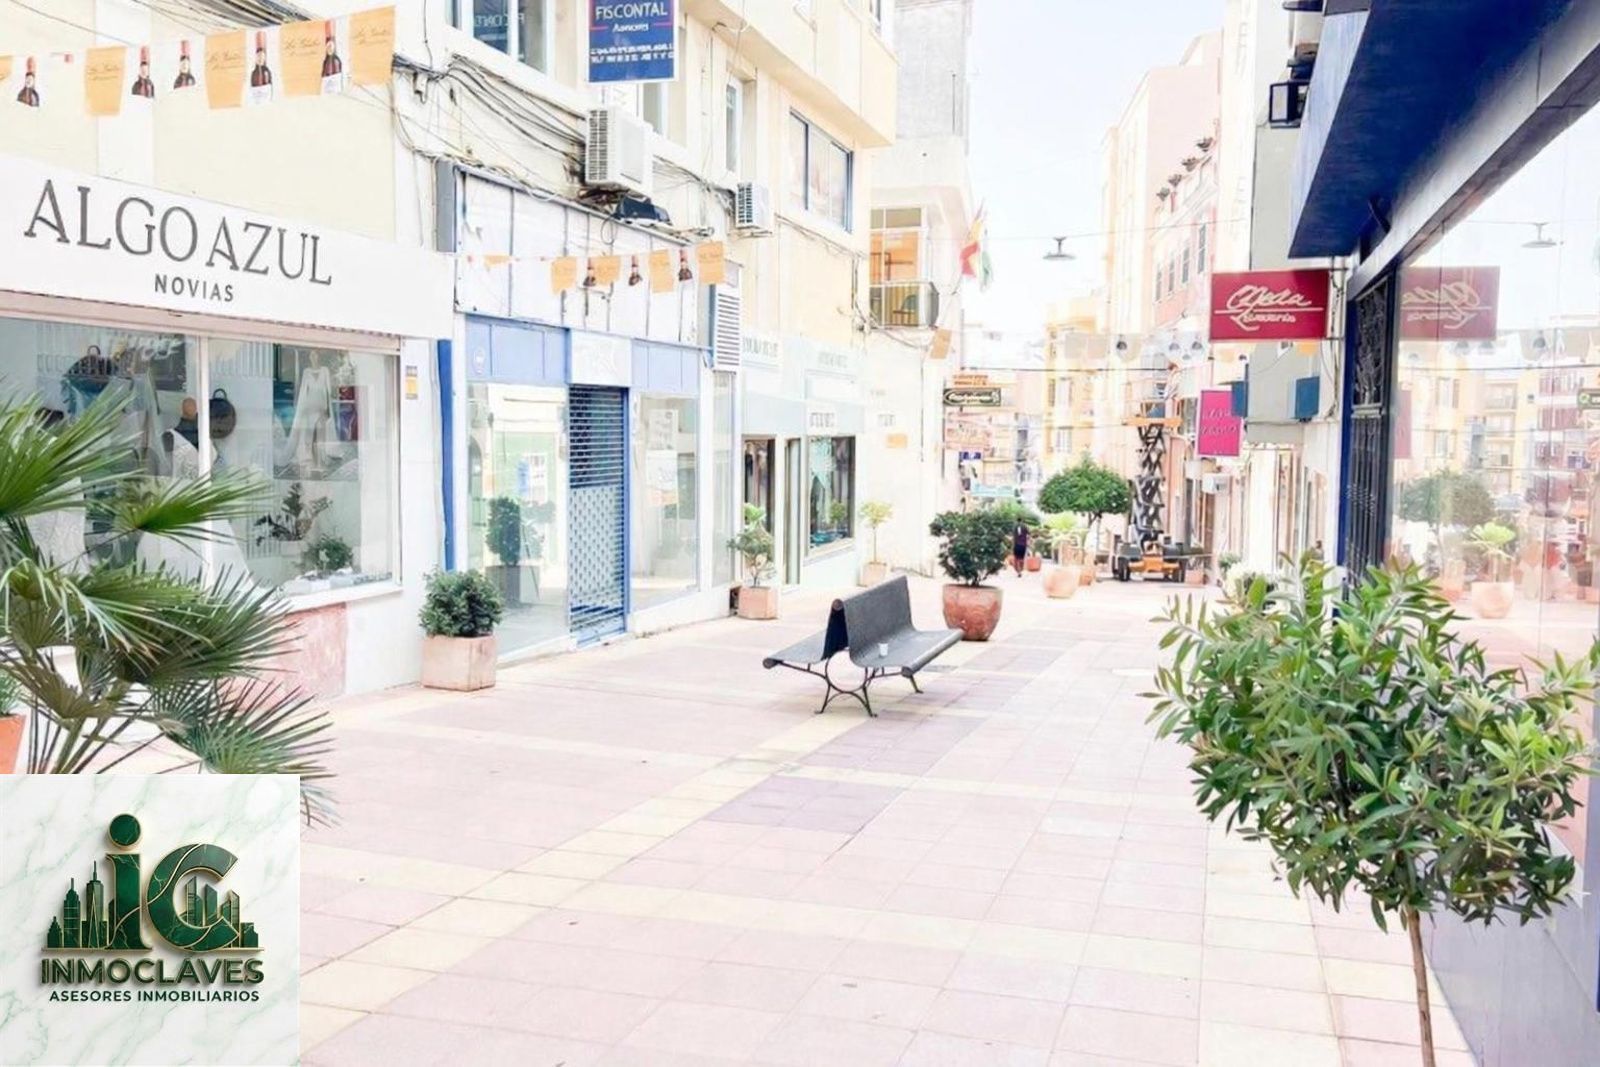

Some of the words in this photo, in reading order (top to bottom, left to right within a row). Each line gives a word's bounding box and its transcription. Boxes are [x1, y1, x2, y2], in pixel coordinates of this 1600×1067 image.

[595, 2, 668, 21] FISCONTAL
[23, 179, 200, 262] ALGO
[205, 216, 332, 285] AZUL
[154, 273, 234, 302] NOVIAS
